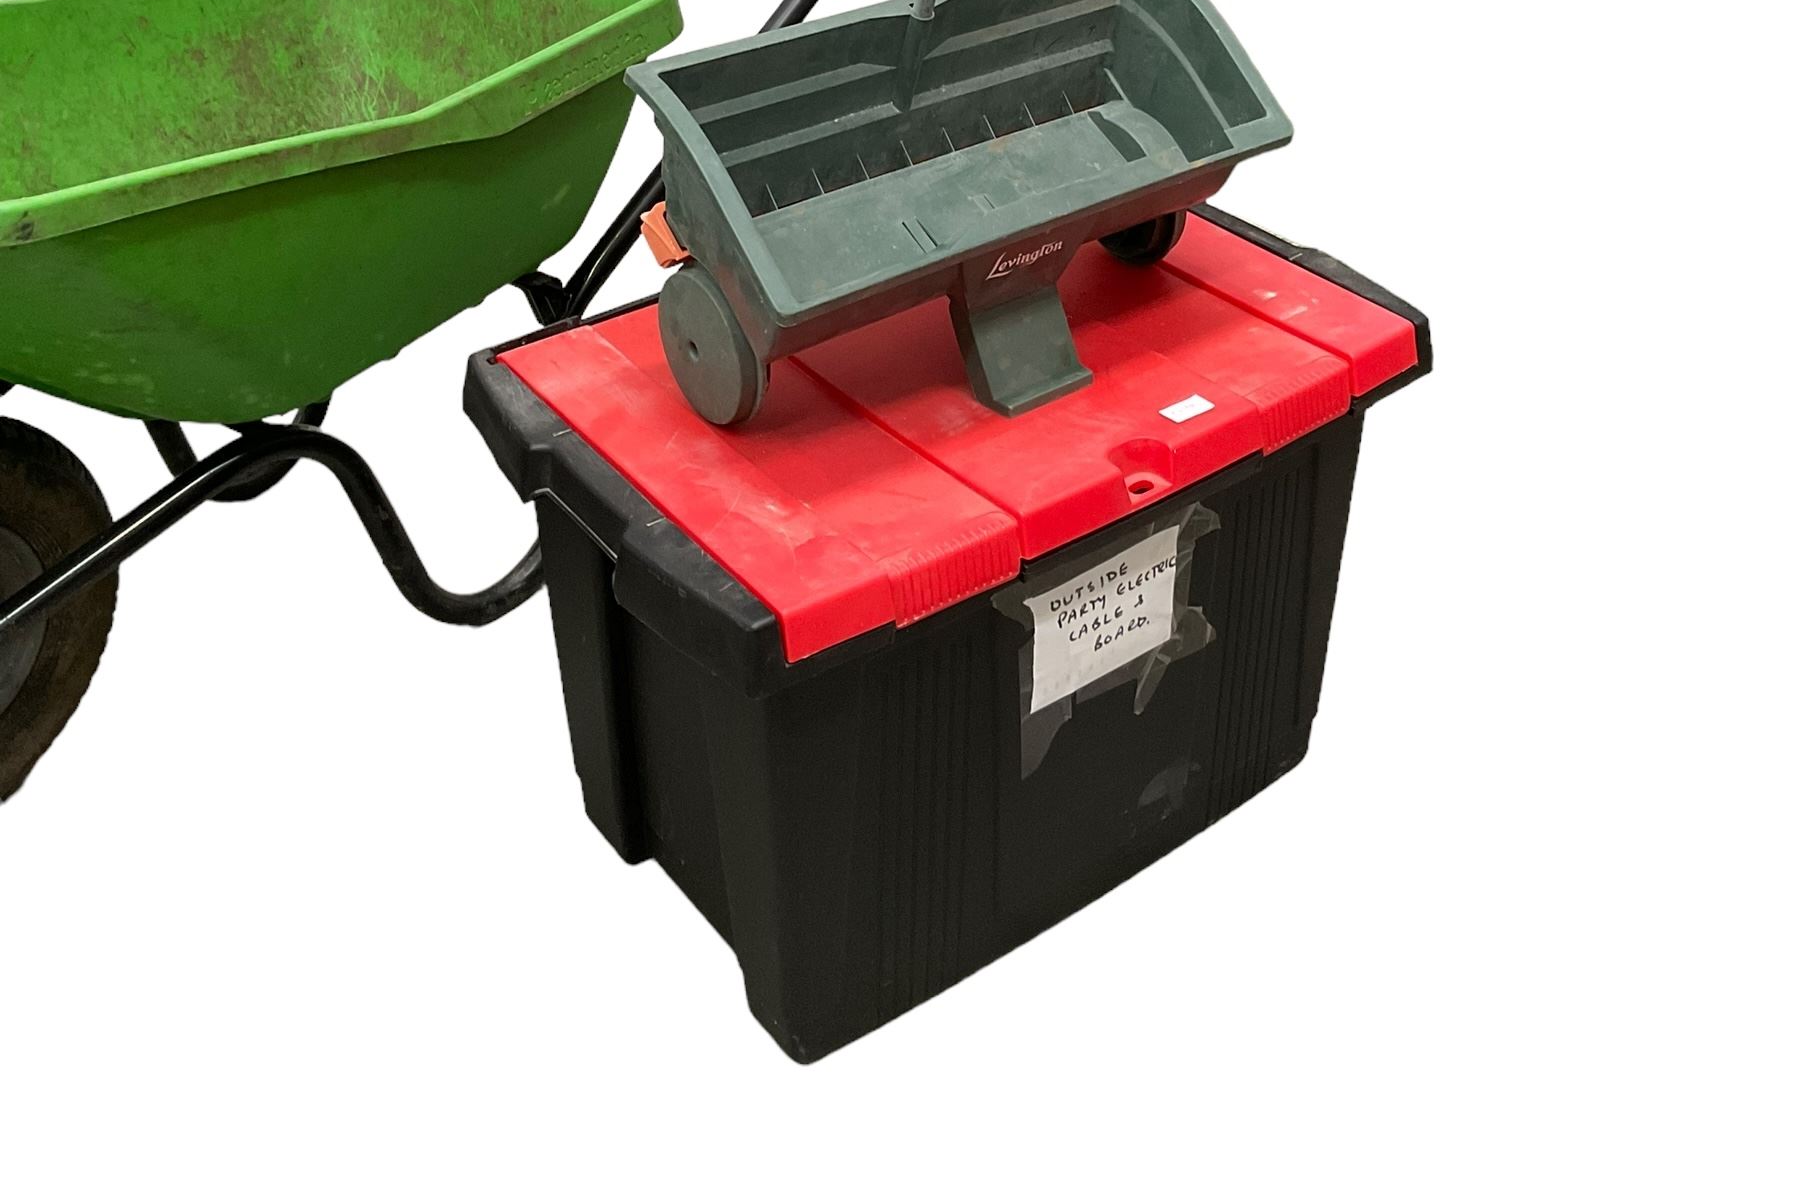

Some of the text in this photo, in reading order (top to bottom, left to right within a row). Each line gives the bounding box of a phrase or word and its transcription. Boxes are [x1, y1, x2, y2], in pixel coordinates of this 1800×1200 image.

[985, 240, 1063, 280] Levington
[1050, 562, 1129, 612] OUTSIDE
[1057, 555, 1177, 629] PARTY ELECTRIC
[1069, 607, 1124, 642] CABLE
